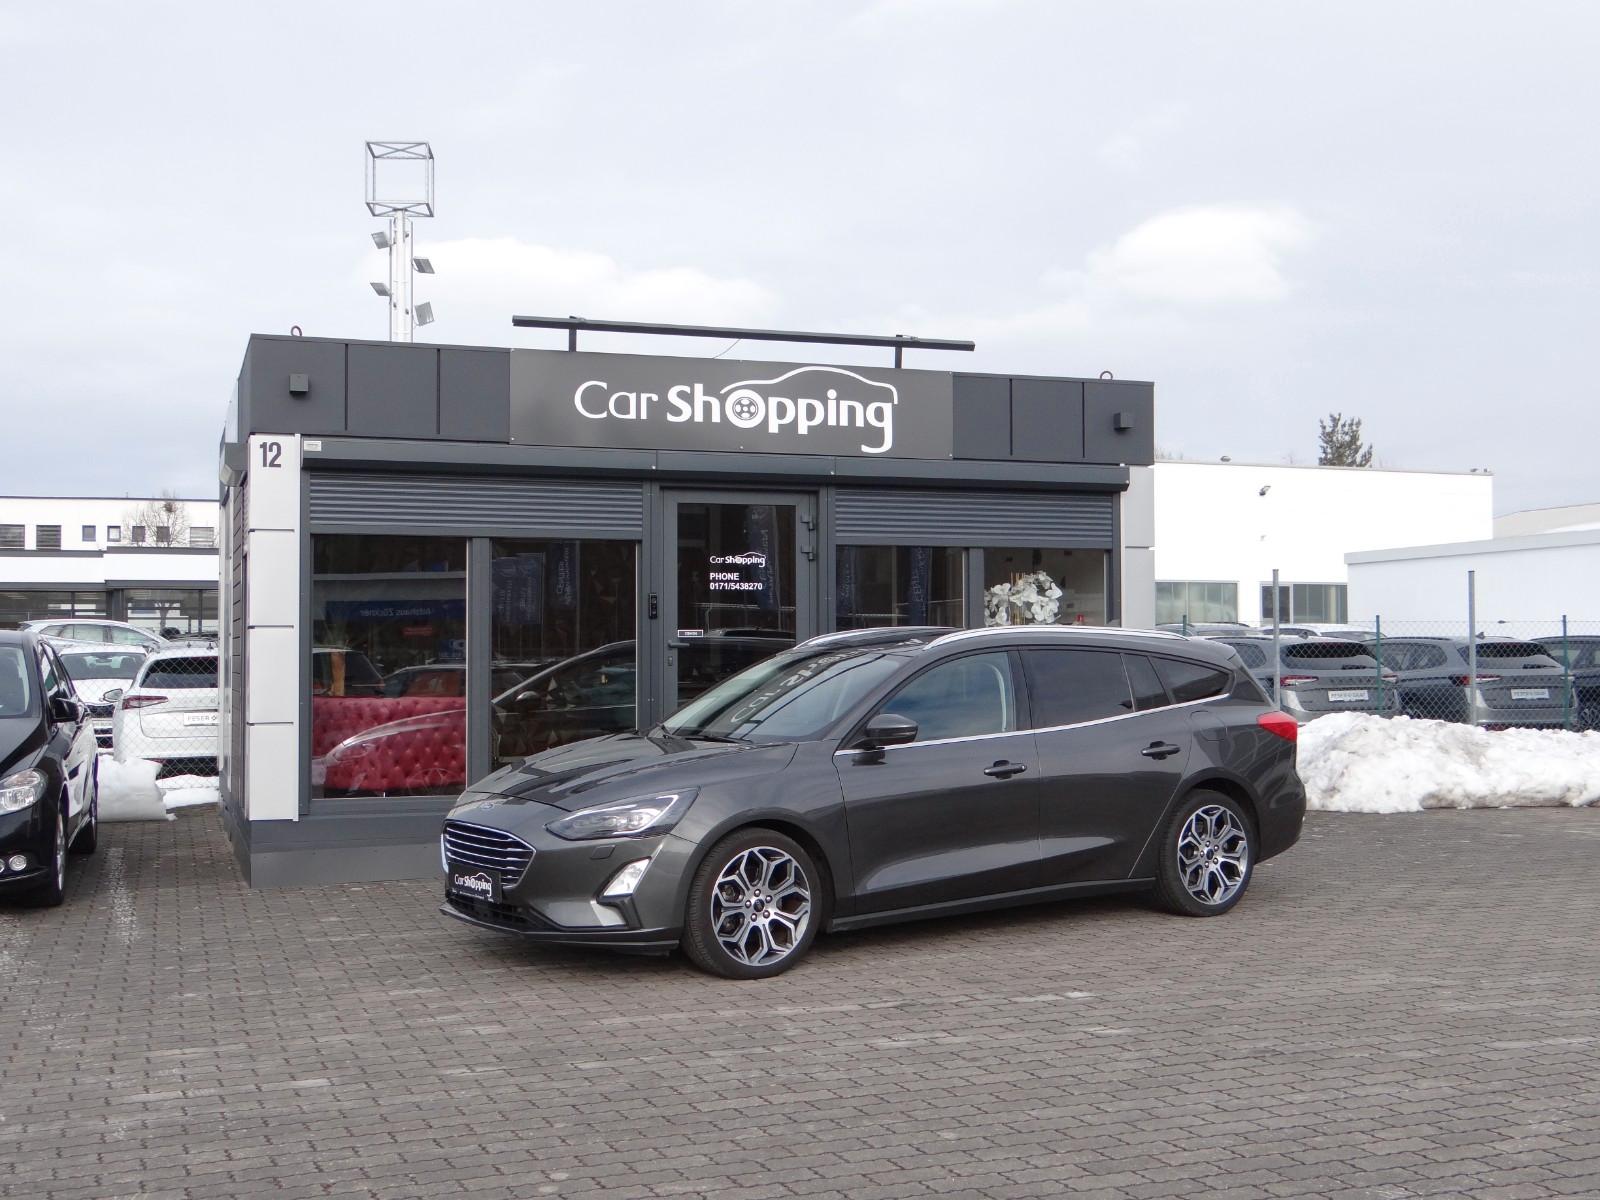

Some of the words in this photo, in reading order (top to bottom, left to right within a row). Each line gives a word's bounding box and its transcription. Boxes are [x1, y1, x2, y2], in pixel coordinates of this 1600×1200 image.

[574, 380, 658, 420] Car
[666, 380, 897, 454] Shopping
[259, 441, 282, 468] 12
[709, 555, 725, 564] Car
[725, 554, 766, 568] Shopping
[709, 572, 740, 581] PHONE
[709, 582, 763, 590] 0171/5438270
[454, 873, 465, 885] Car
[464, 874, 492, 897] Shopping
